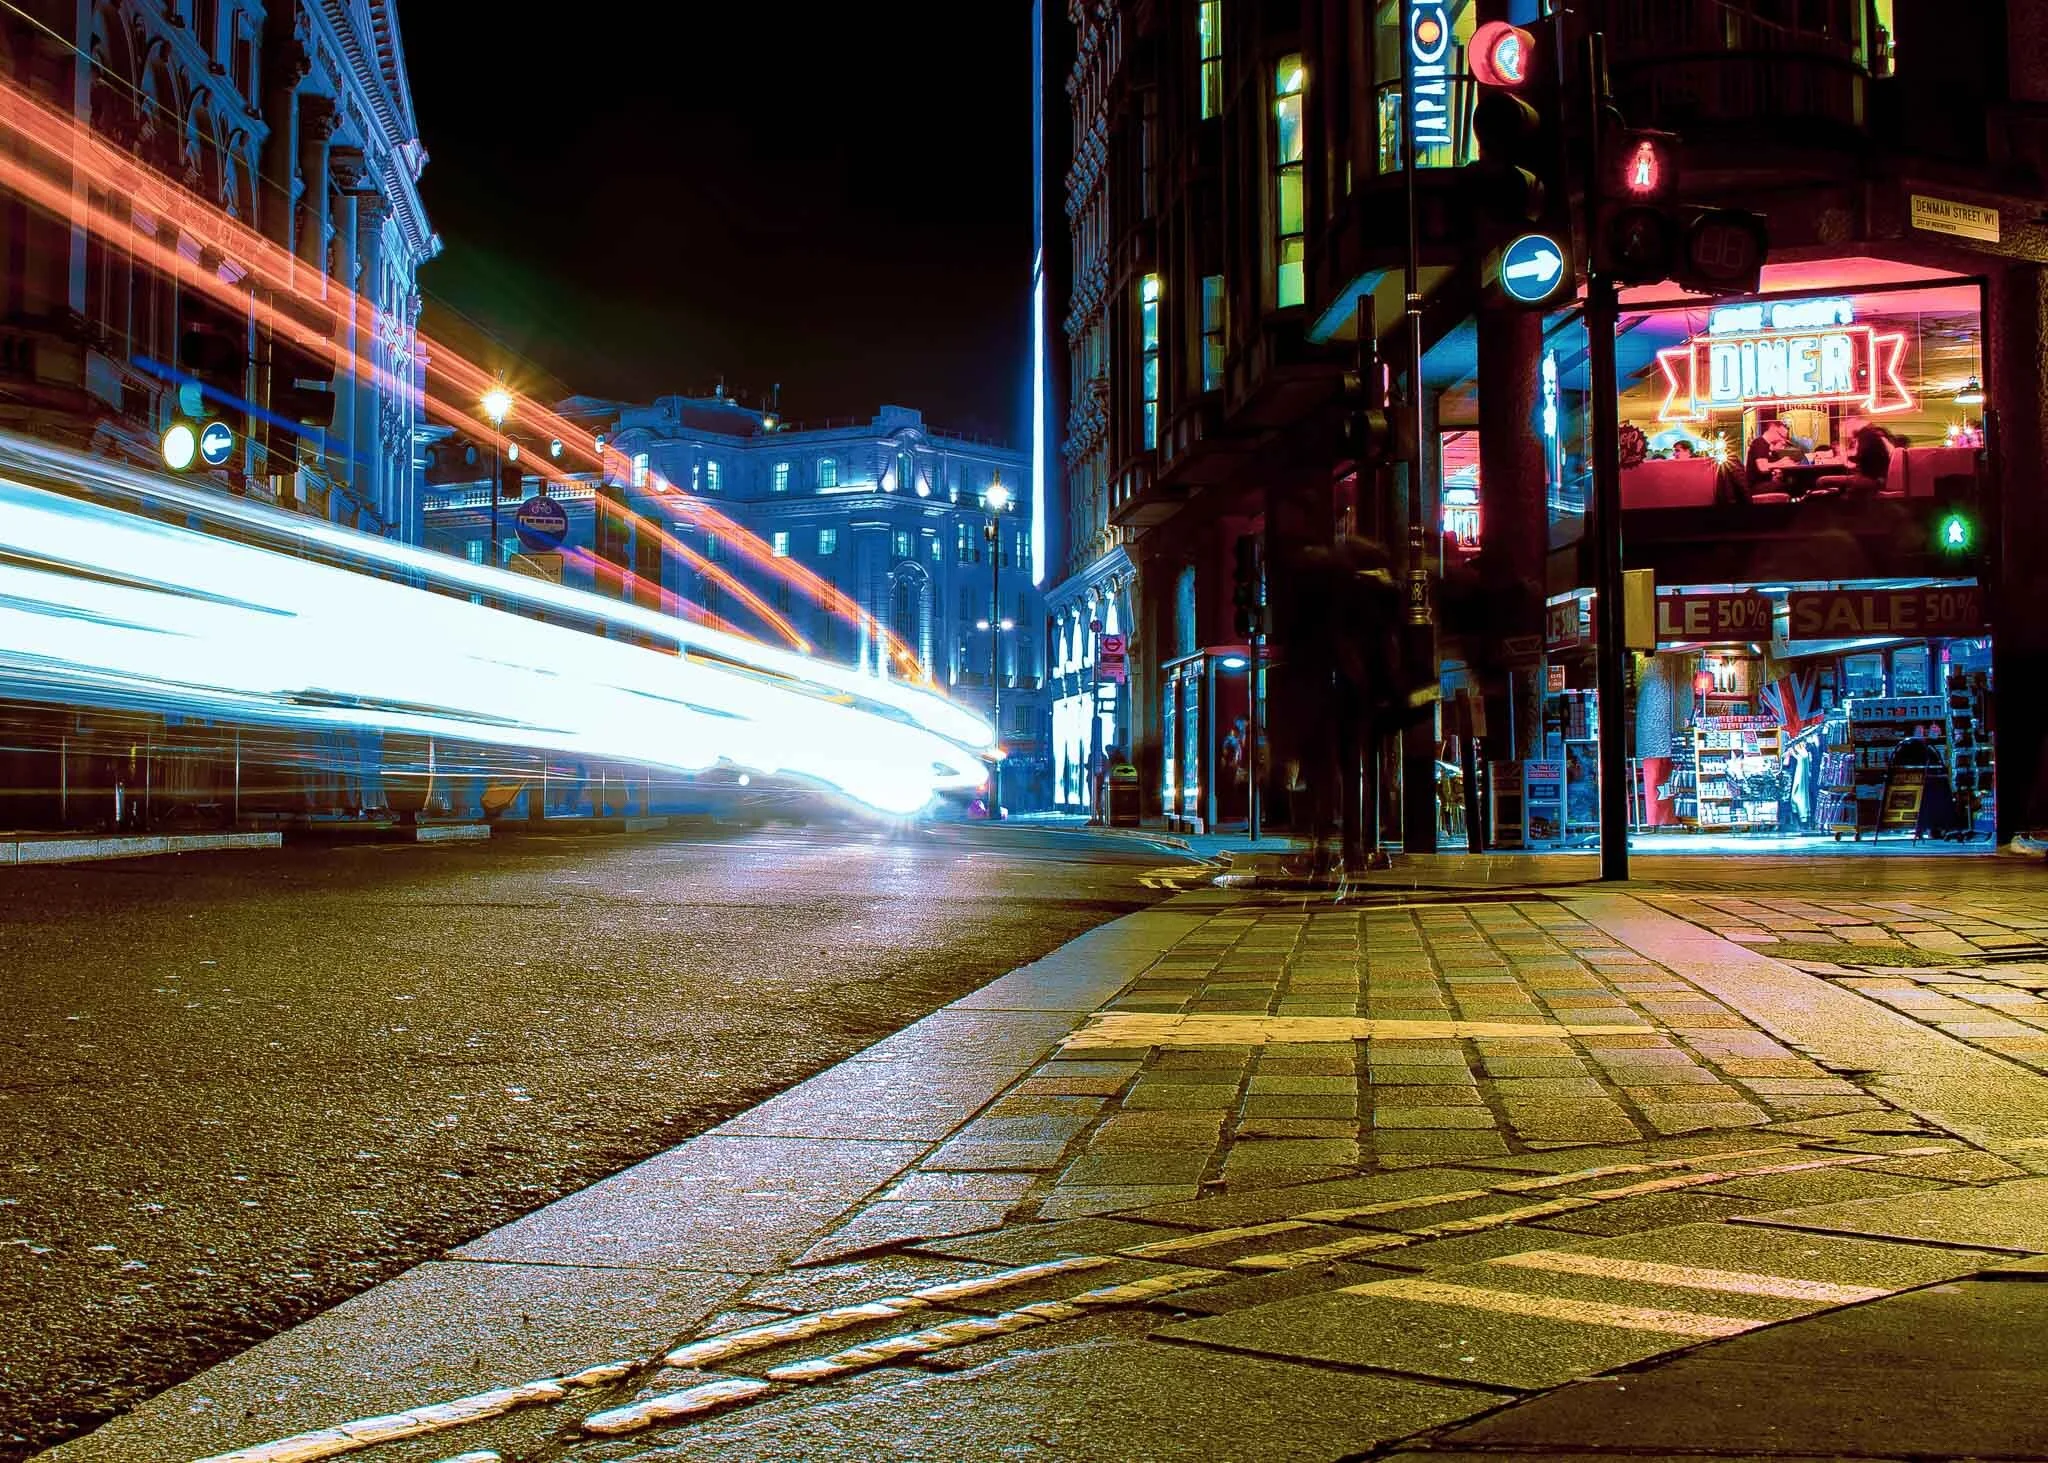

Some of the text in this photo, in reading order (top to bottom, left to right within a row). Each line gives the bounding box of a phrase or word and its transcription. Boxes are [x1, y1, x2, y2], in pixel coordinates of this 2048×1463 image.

[1915, 199, 1951, 217] DENMAN
[1952, 207, 1981, 224] STREET
[1710, 335, 1852, 401] DINER
[1717, 599, 1766, 628] 50%
[1799, 592, 1977, 634] SALE 50%
